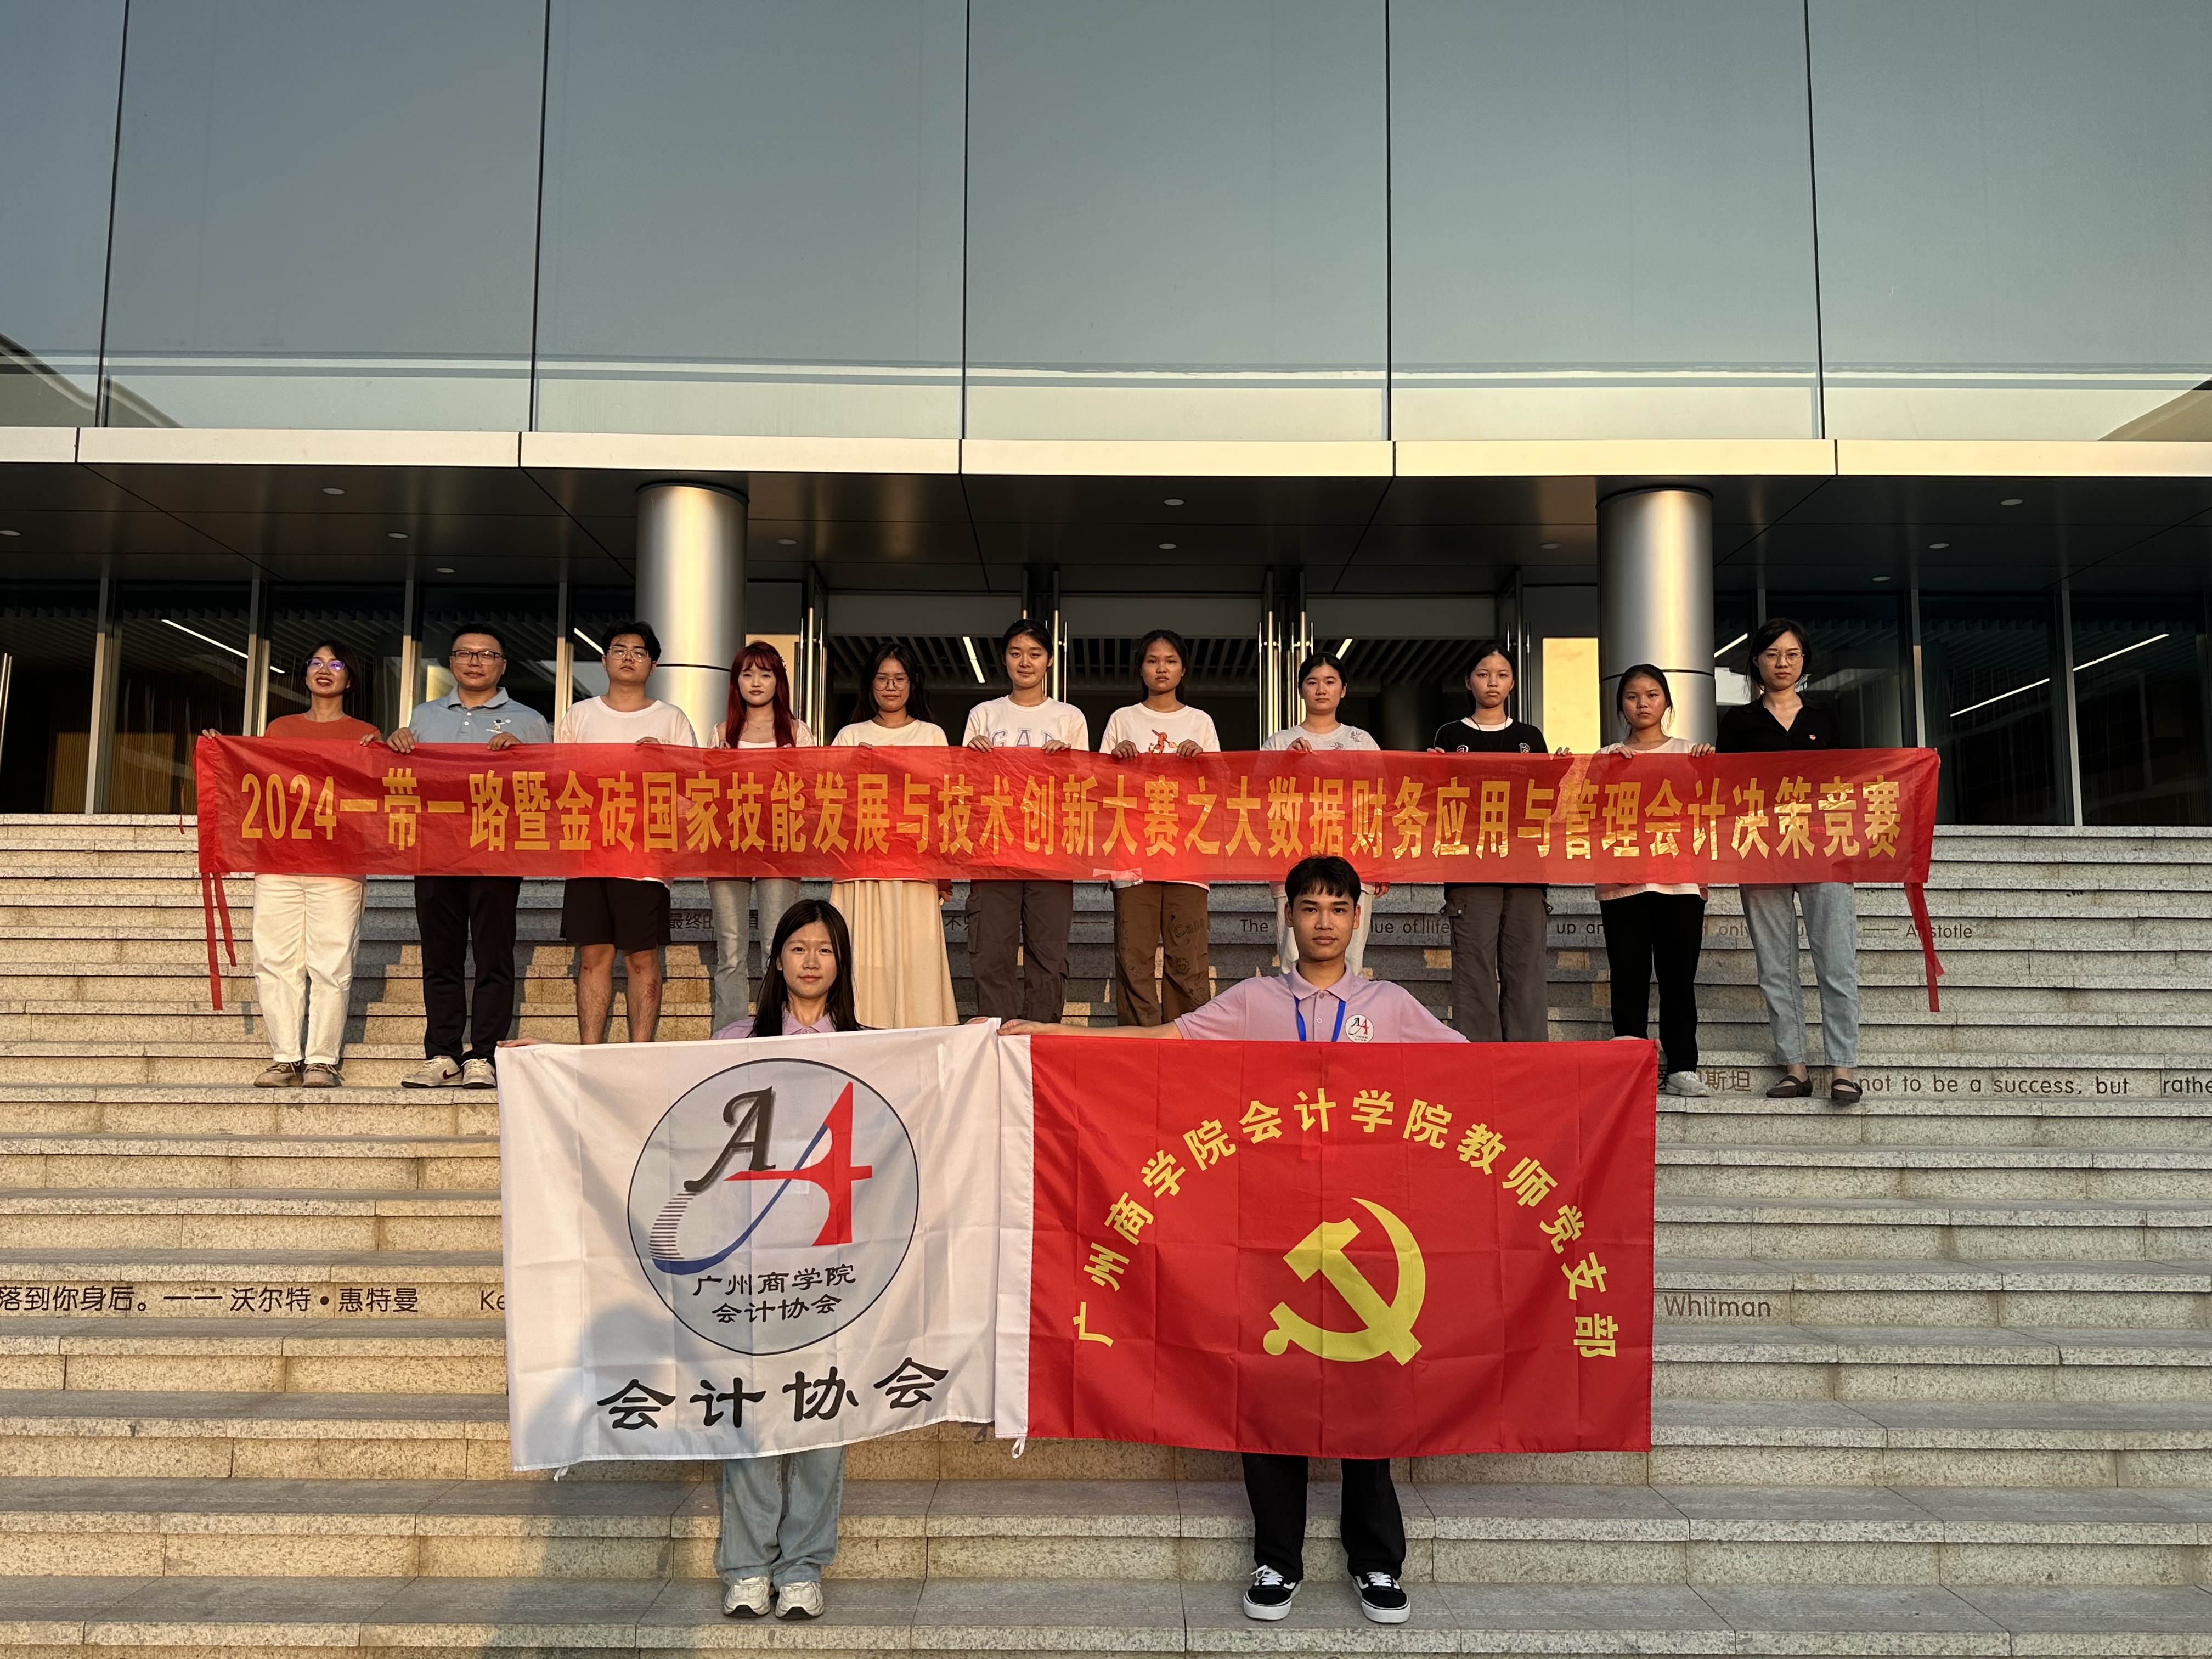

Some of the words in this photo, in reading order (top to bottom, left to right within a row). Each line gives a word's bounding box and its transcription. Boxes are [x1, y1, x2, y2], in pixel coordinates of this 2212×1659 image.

[241, 768, 1901, 860] 2024一带一路暨金砖国家技能发展与技术创新大赛之大数据财务应用与管理会计决策竞赛
[1240, 918, 1269, 932] The
[1402, 918, 1420, 934] of
[1426, 918, 1450, 934] life
[1586, 923, 1604, 935] an
[1905, 924, 1972, 939] Astotle
[1859, 1075, 1892, 1092] not
[1902, 1075, 1921, 1092] to
[1933, 1074, 1959, 1093] be
[1970, 1079, 1982, 1093] a
[1993, 1079, 2083, 1095] success,
[2096, 1075, 2129, 1094] but
[2163, 1076, 2212, 1093] rathe
[1073, 1088, 1619, 1358] 广州商学院会计学院教师党支部
[692, 1263, 856, 1297] 广州商学院
[480, 1290, 505, 1311] Ke
[712, 1293, 842, 1323] 会计协会
[1664, 1293, 1771, 1317] Whitman
[597, 1357, 949, 1430] 会计协会
